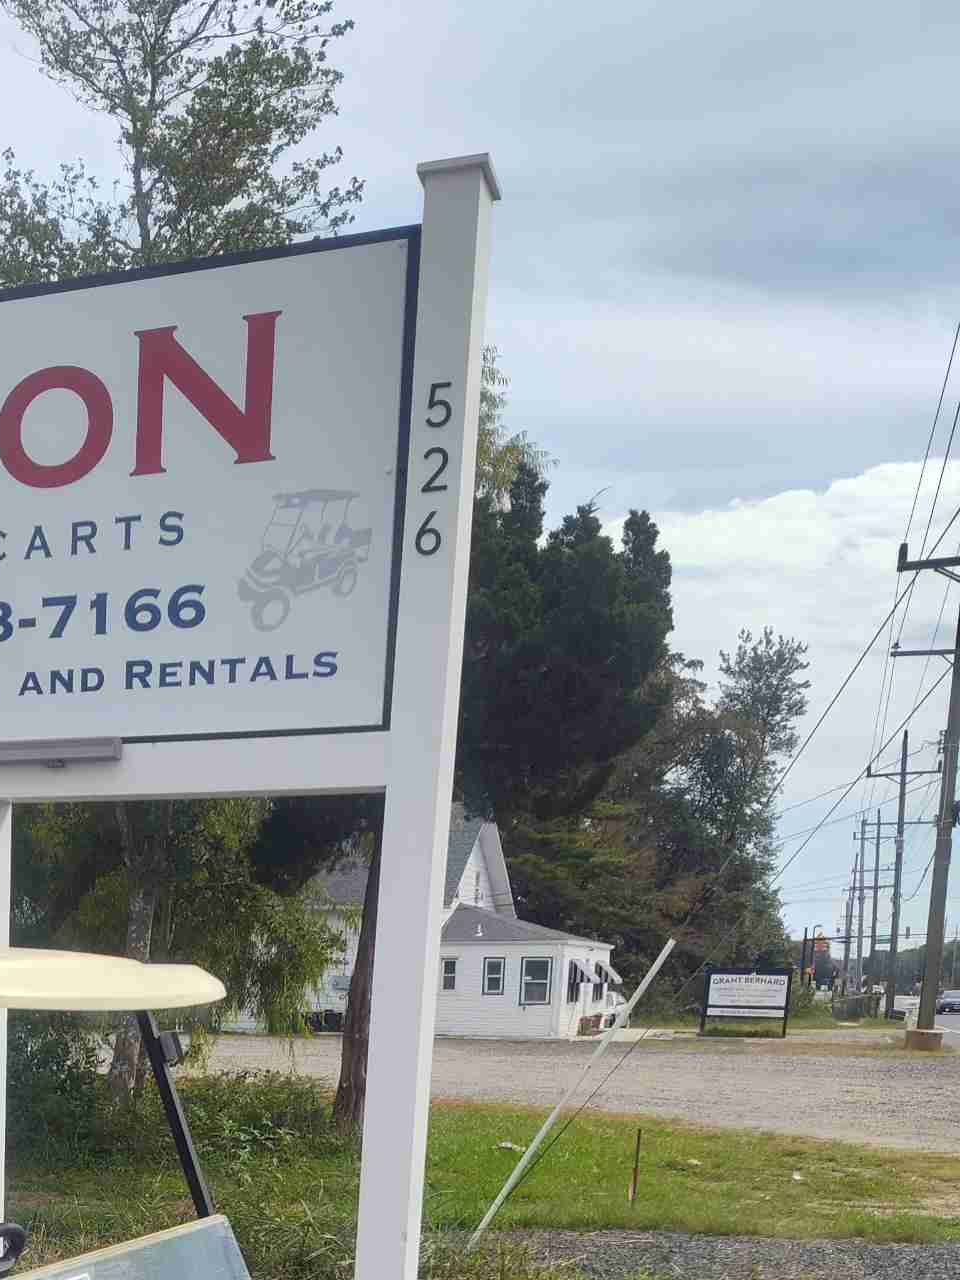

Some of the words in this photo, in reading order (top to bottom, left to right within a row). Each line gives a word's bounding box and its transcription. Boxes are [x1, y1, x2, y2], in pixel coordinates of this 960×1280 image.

[415, 381, 453, 556] 526
[18, 666, 105, 697] AND
[123, 651, 340, 691] RENTALS
